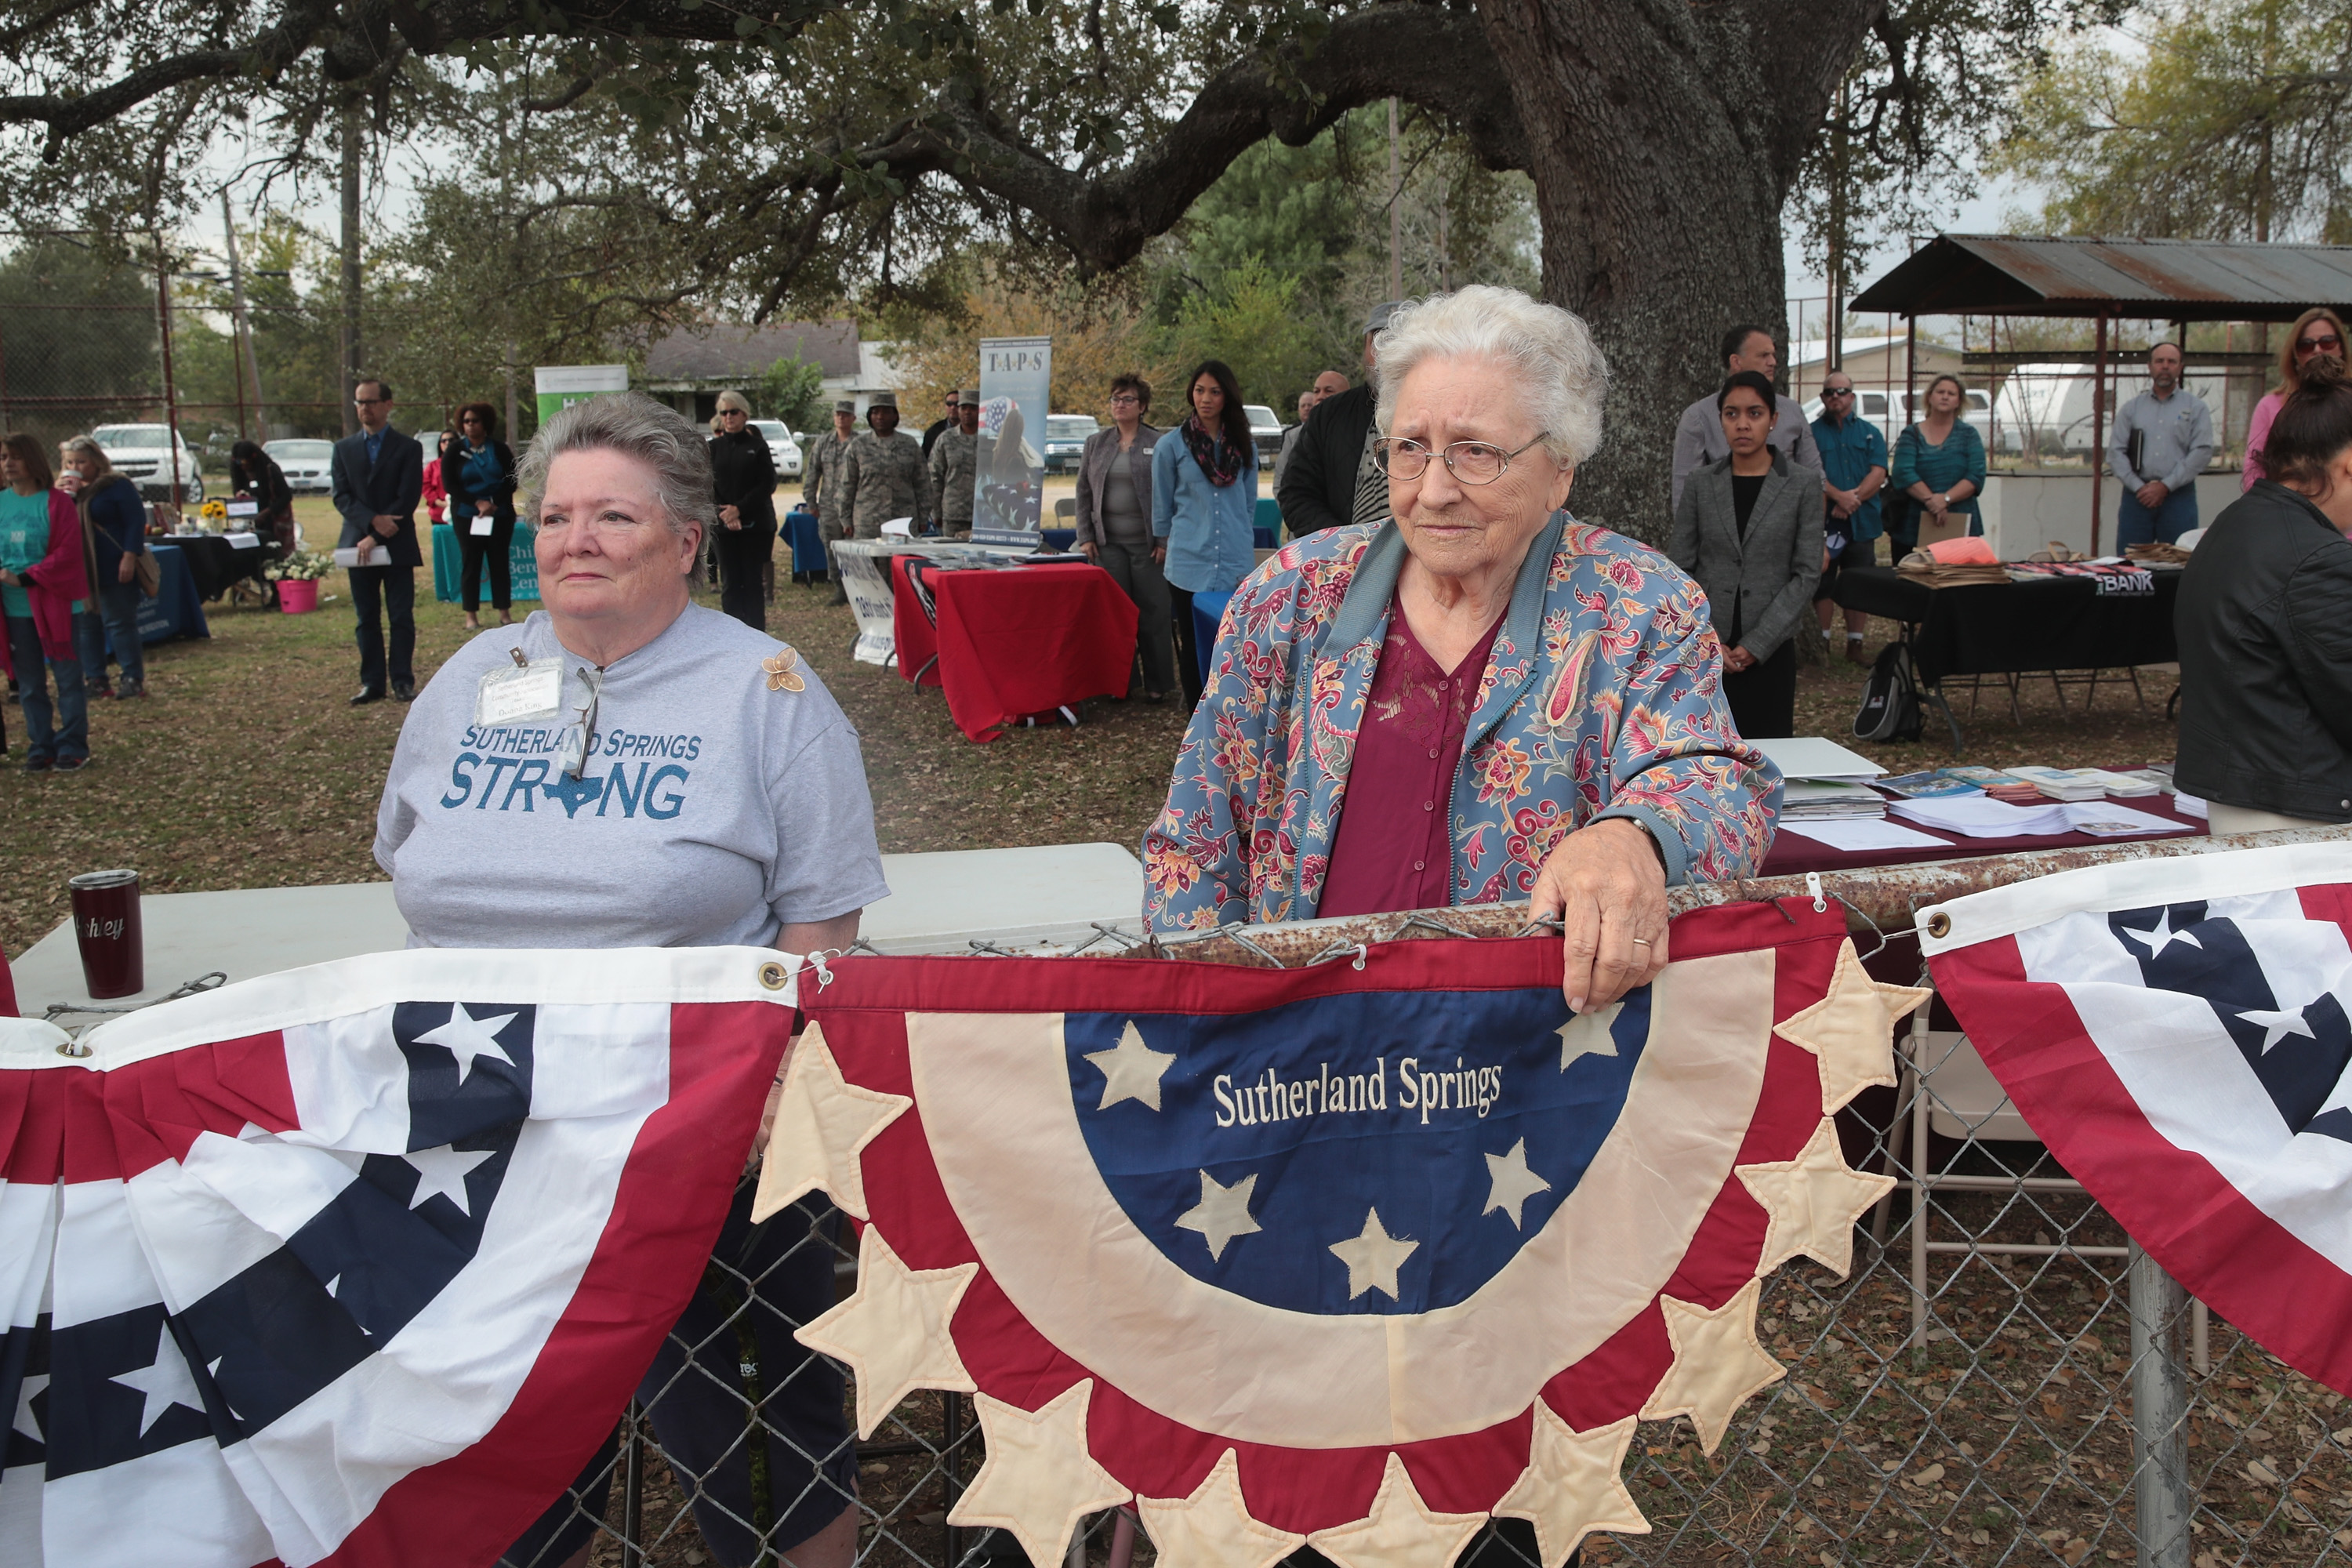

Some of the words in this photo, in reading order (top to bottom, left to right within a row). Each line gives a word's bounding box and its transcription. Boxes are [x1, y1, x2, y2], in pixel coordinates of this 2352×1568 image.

[509, 545, 536, 559] Chi
[604, 728, 702, 760] SPRINGS
[1213, 1057, 1388, 1127] Sutherland
[1399, 1055, 1502, 1125] Springs
